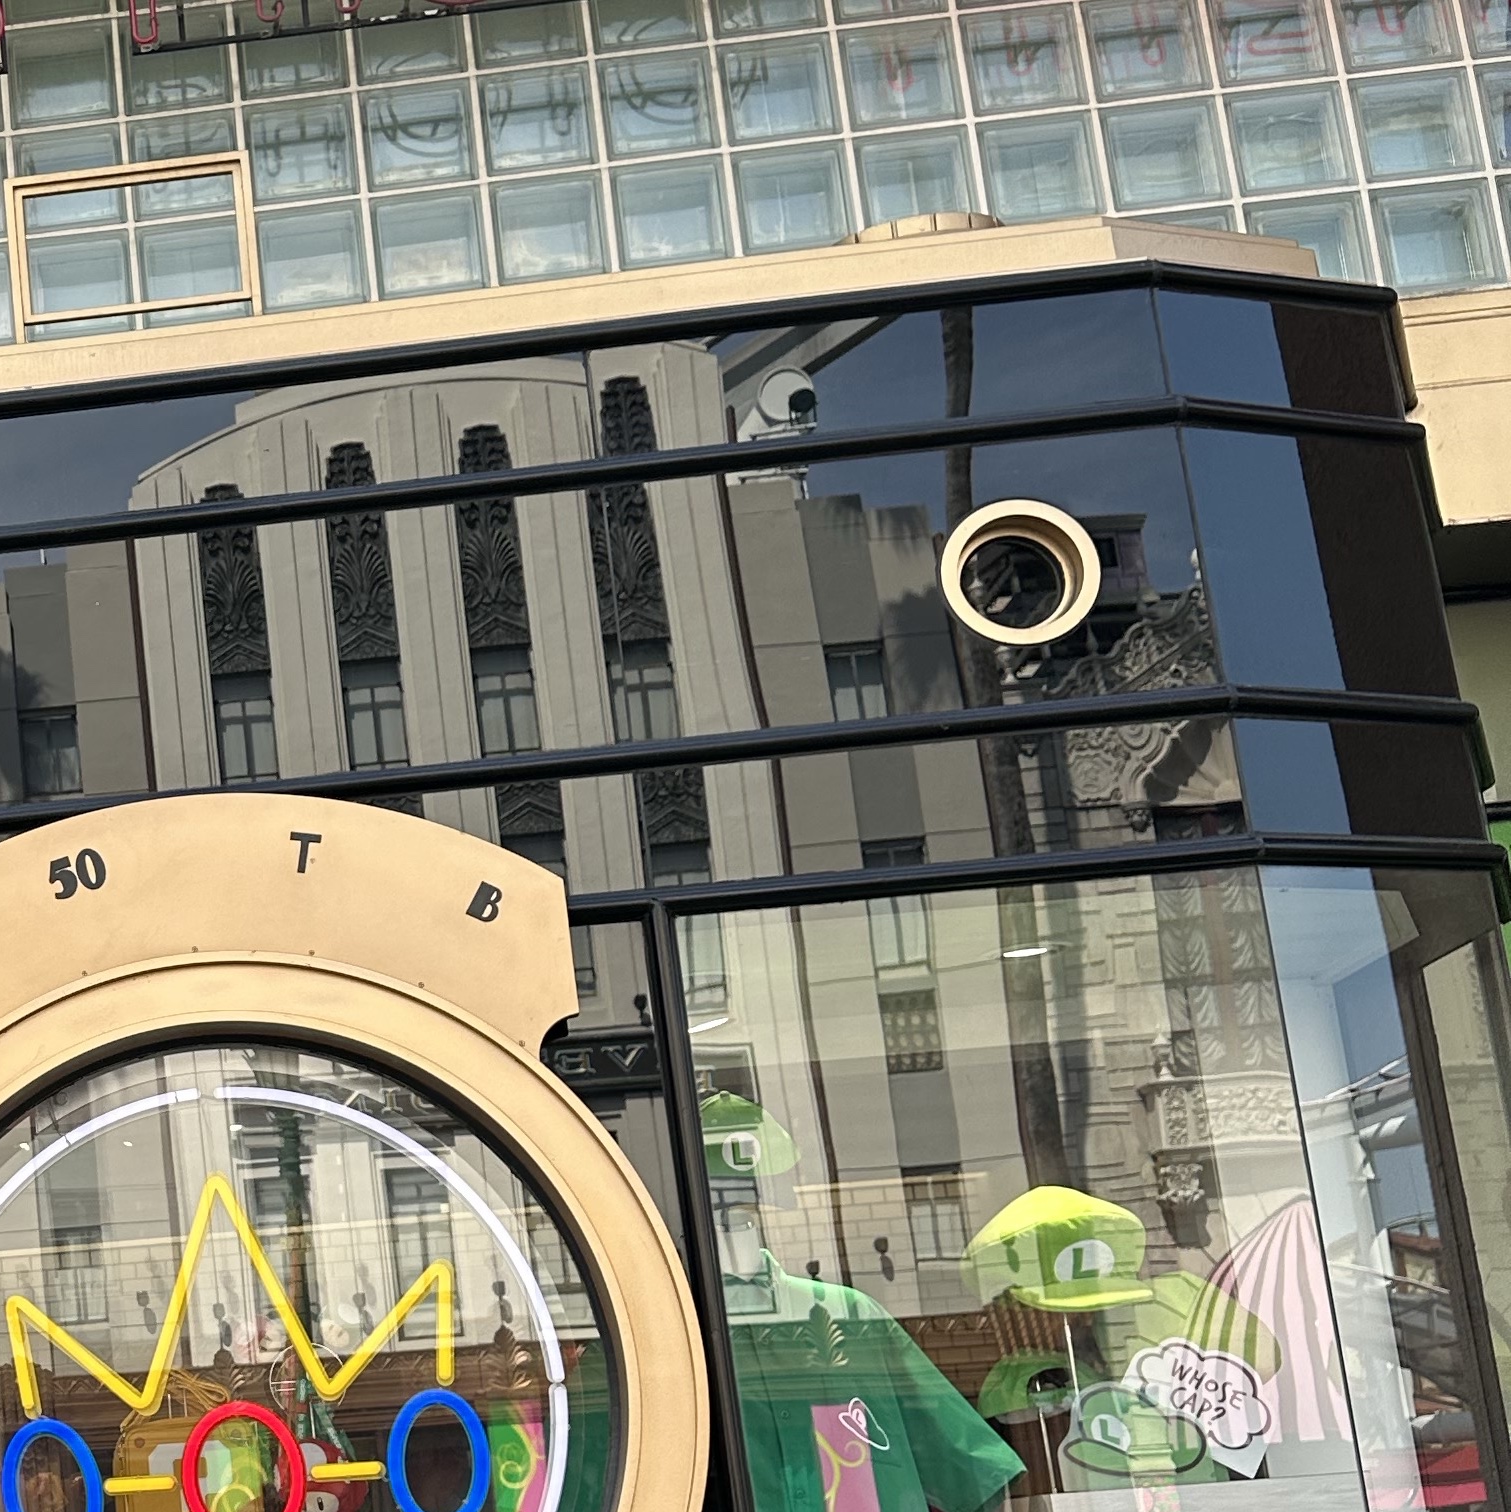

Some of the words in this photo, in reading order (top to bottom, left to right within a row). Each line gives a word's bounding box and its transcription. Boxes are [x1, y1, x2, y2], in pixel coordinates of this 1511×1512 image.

[48, 848, 106, 900] 50
[1169, 1386, 1227, 1426] CAP?
[1171, 1357, 1247, 1411] WHOSE
